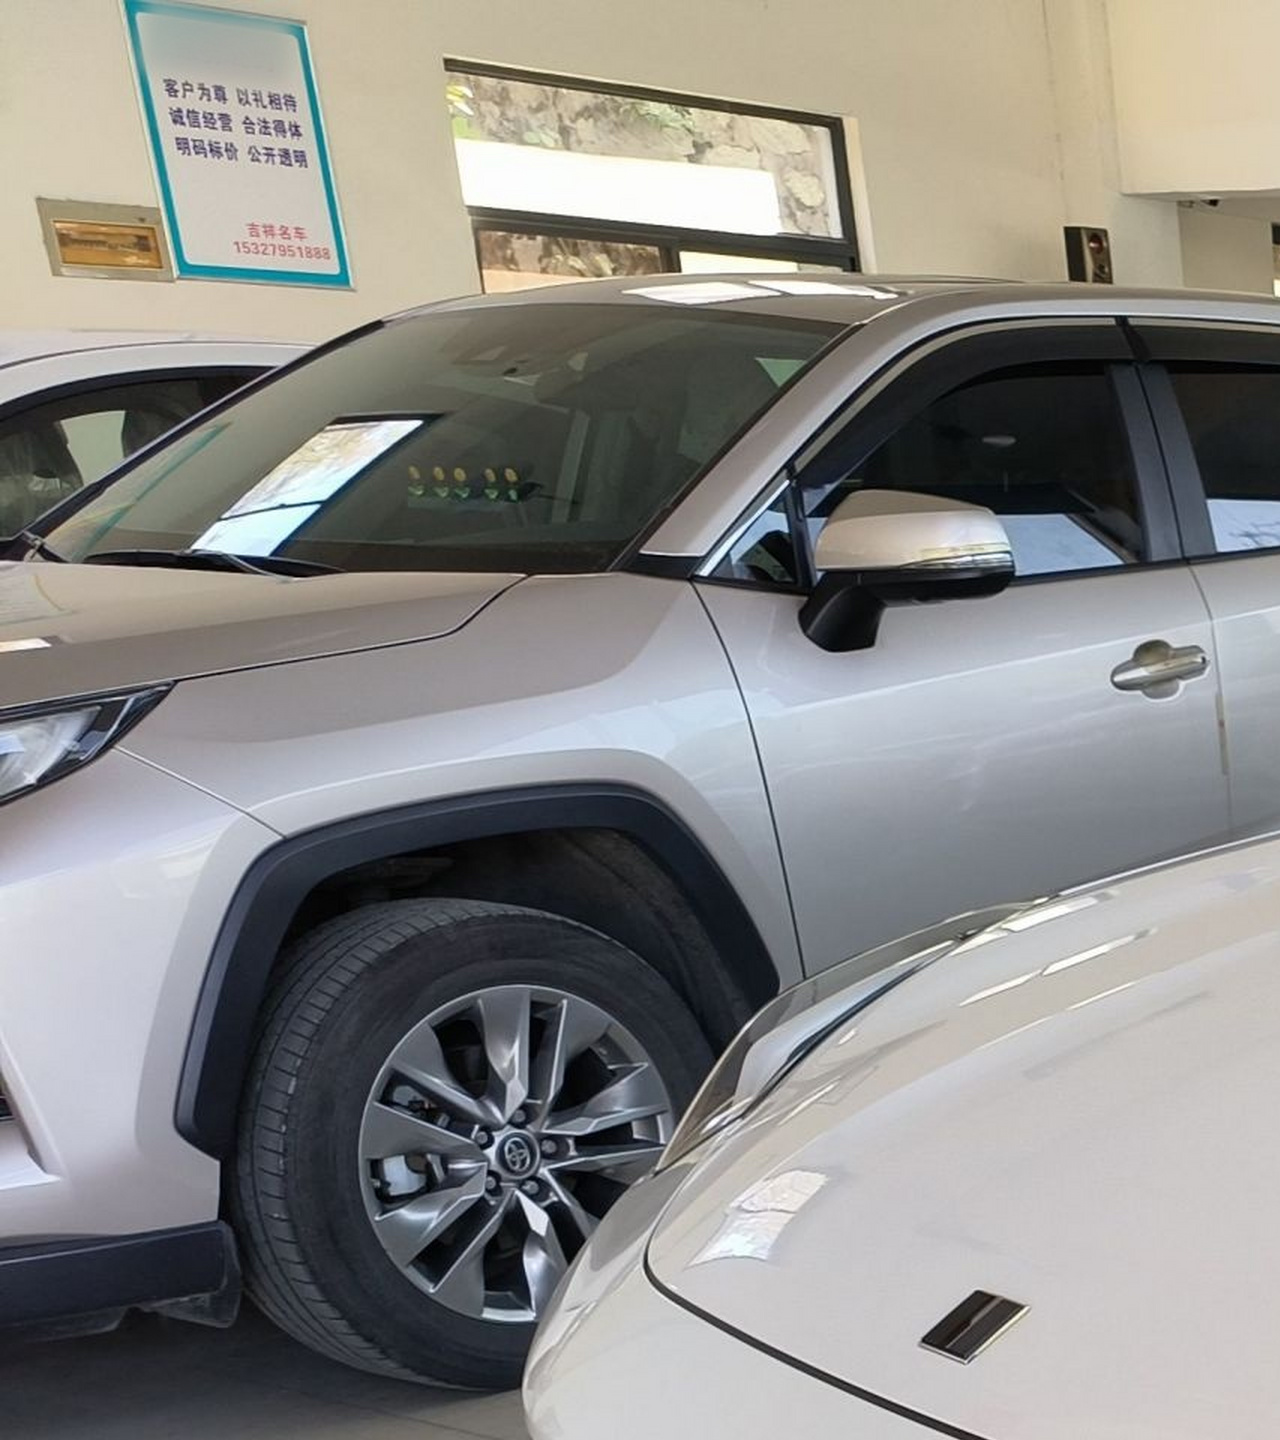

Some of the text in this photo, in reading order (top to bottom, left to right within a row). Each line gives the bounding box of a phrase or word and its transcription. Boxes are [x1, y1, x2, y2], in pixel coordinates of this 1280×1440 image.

[163, 79, 298, 113] 客户为尊 以礼相待
[169, 107, 303, 141] 诚信经营 合法得体
[175, 137, 309, 169] 明码标价 公开透明
[246, 222, 308, 241] 吉祥名车
[233, 241, 331, 260] 15327951888
